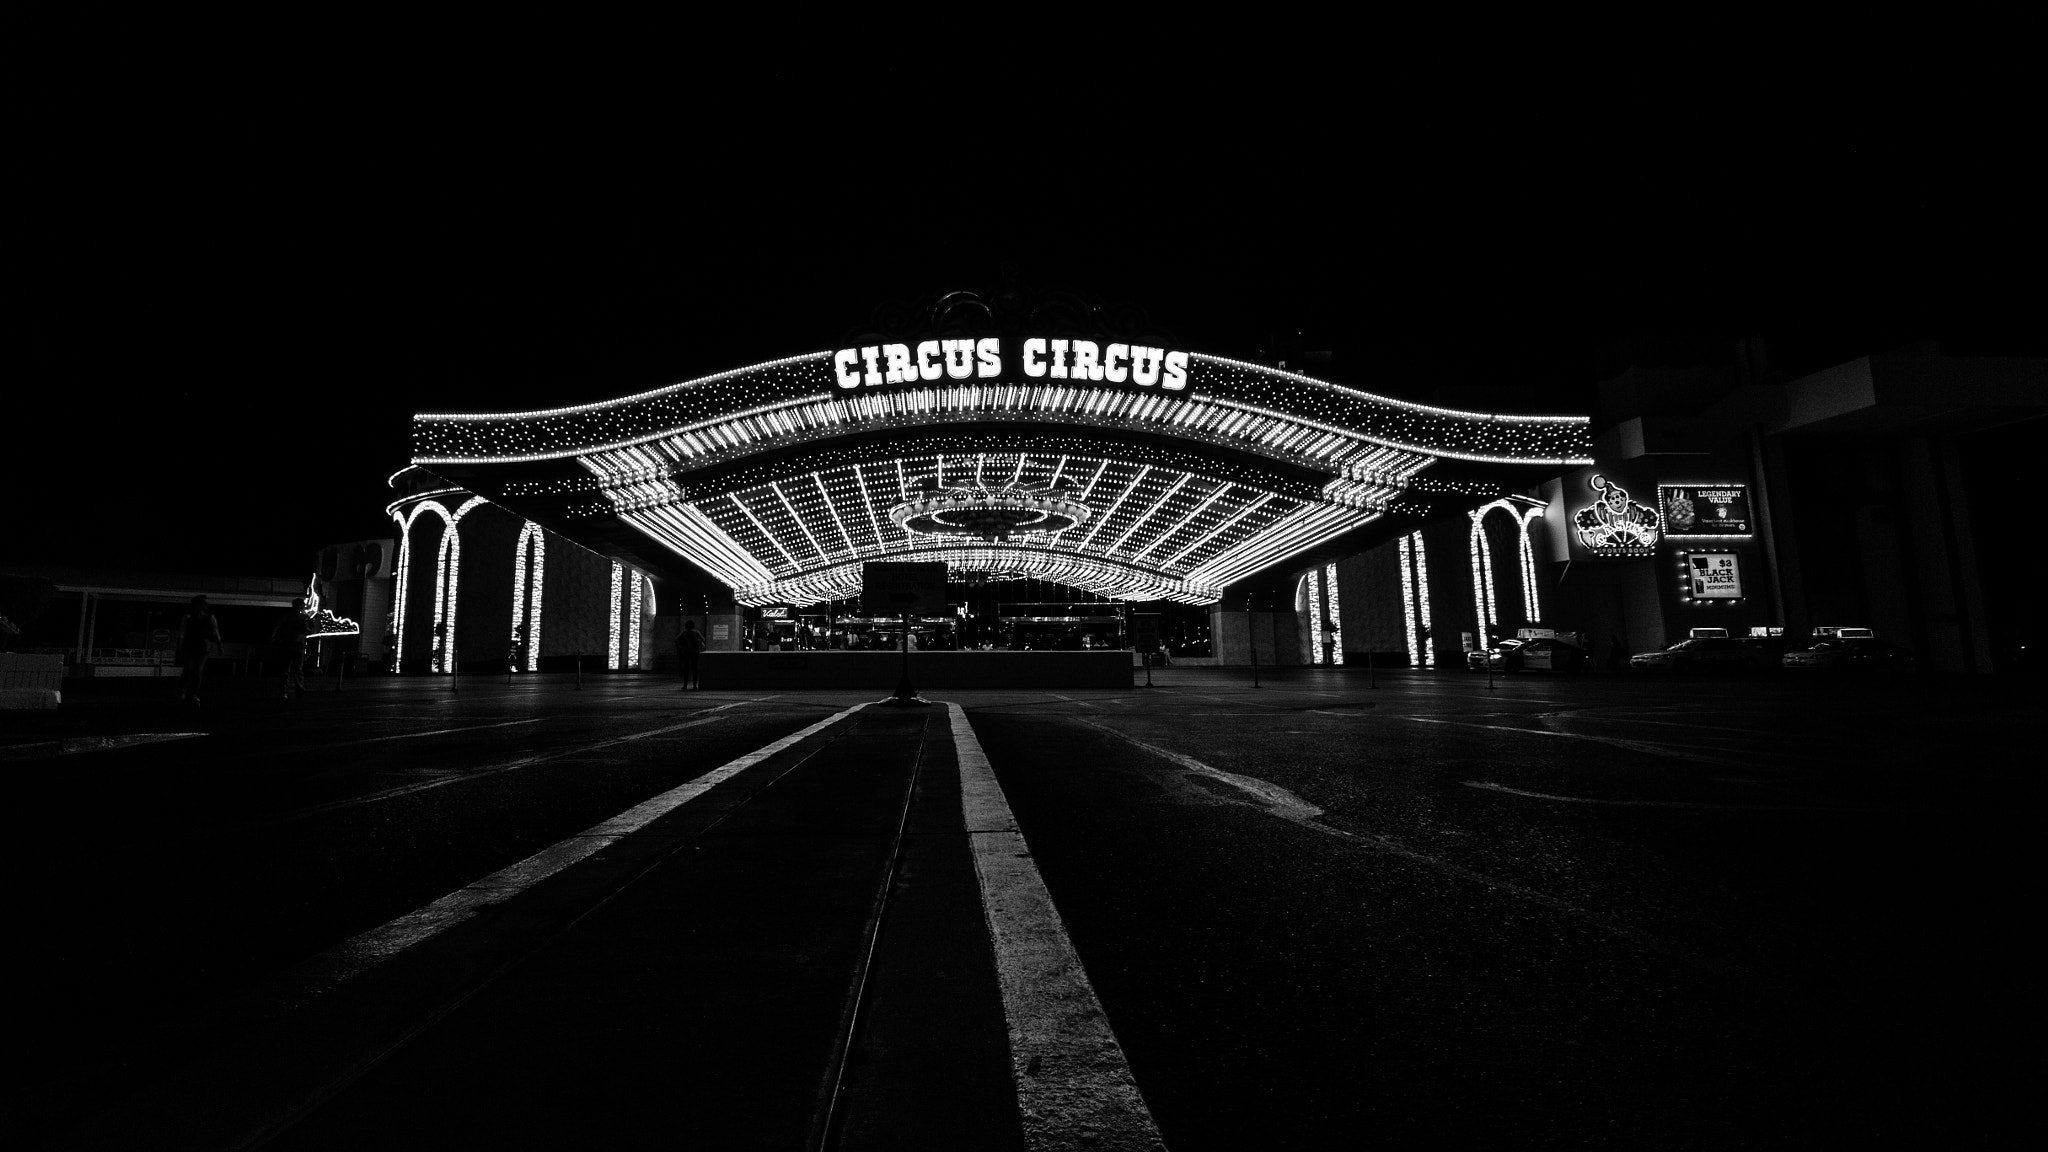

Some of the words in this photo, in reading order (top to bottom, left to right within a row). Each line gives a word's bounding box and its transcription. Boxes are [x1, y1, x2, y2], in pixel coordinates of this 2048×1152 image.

[834, 337, 1002, 389] CIRCUS
[1023, 337, 1189, 390] CIRCUS
[1697, 490, 1741, 498] LEGENDARY
[1699, 569, 1733, 577] BLACK
[762, 609, 787, 618] Valet
